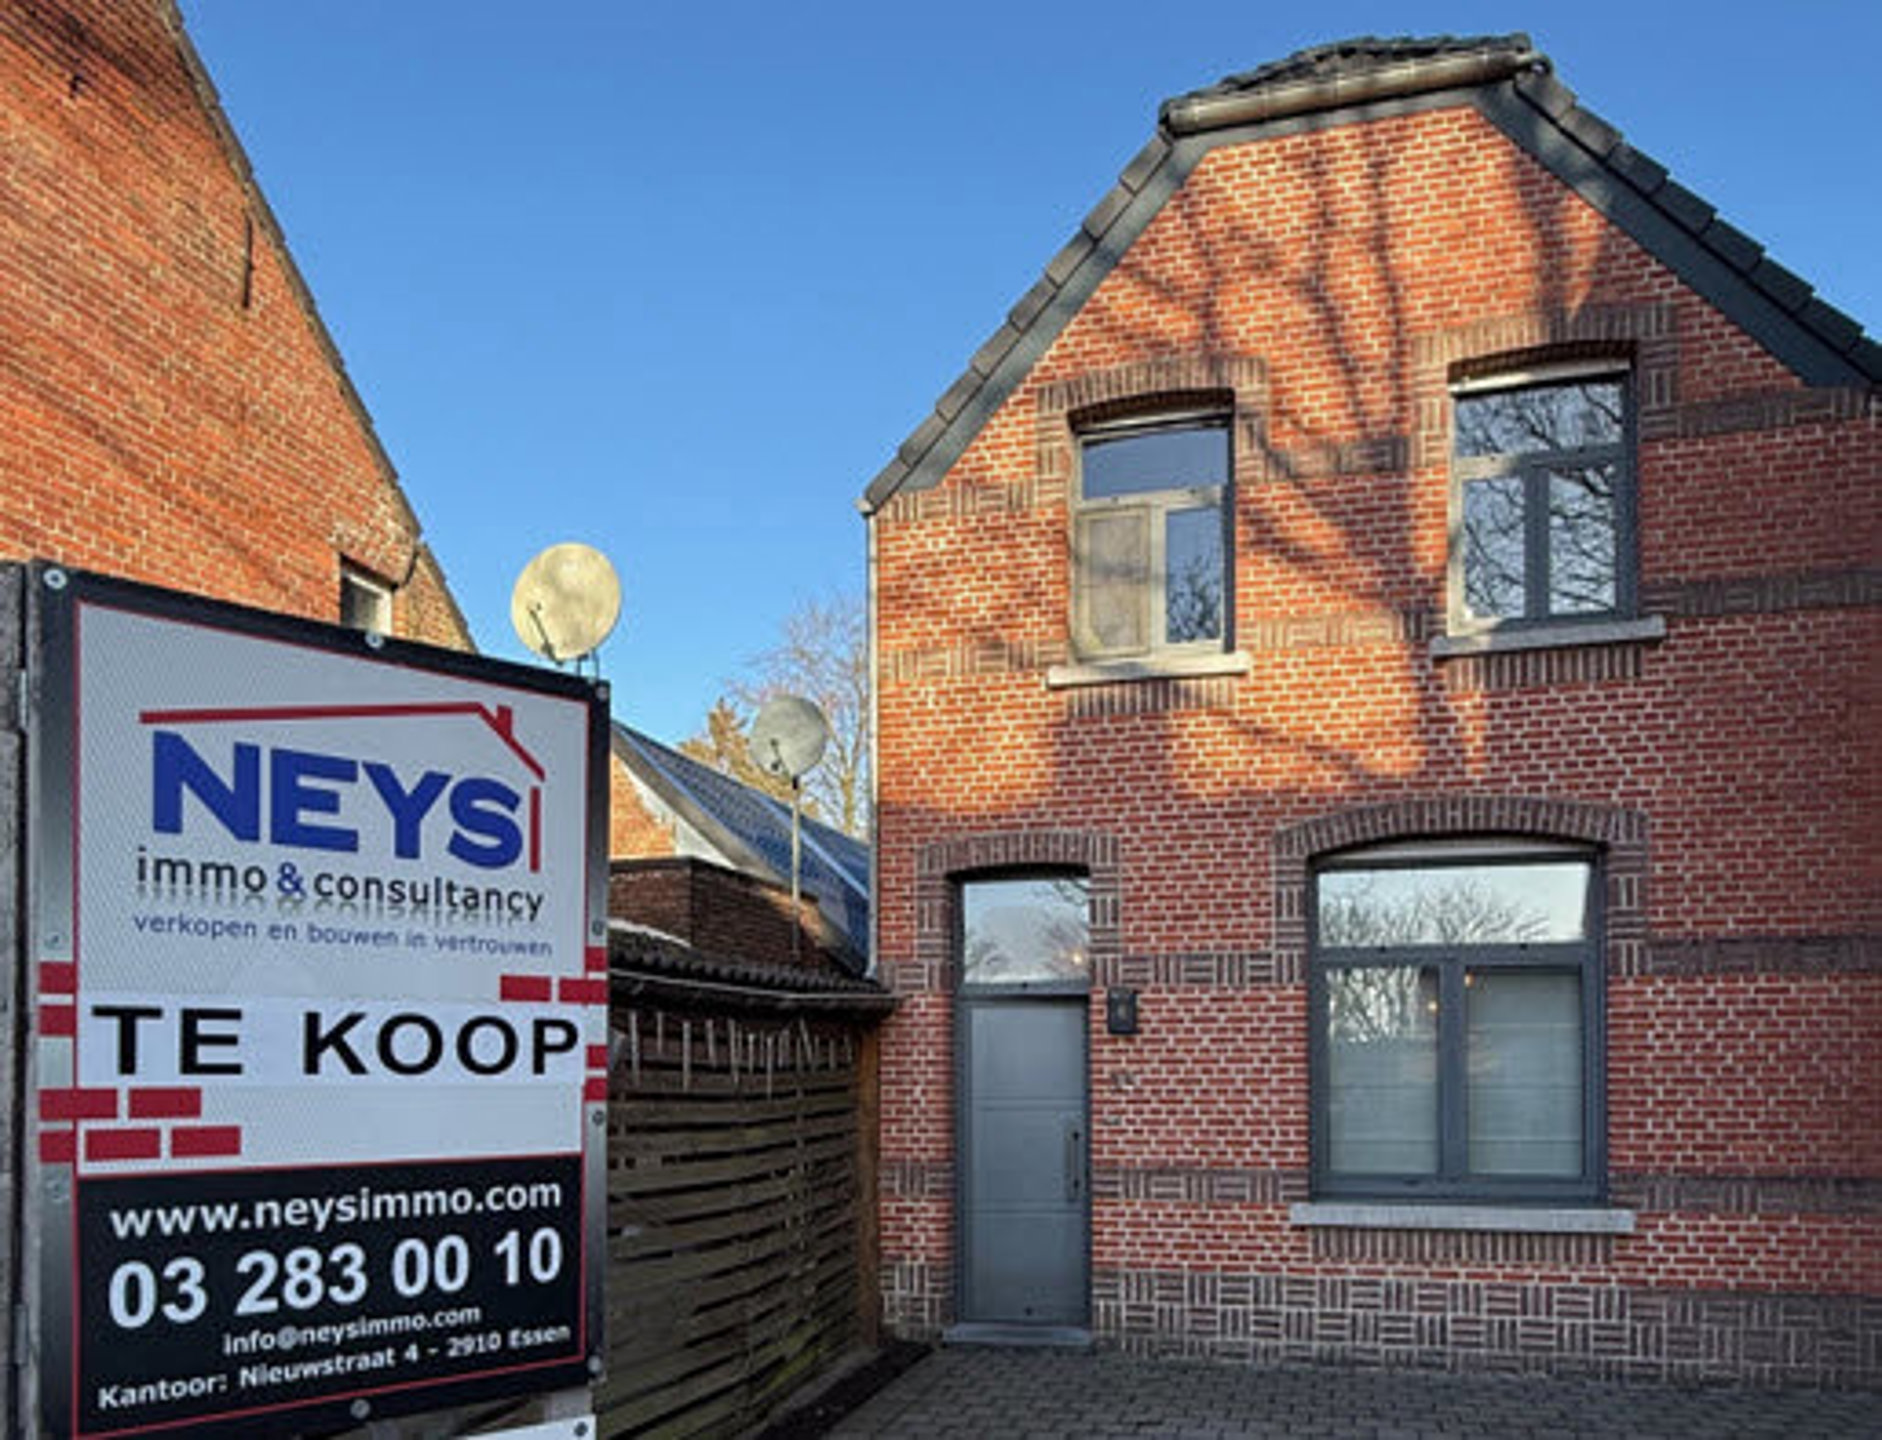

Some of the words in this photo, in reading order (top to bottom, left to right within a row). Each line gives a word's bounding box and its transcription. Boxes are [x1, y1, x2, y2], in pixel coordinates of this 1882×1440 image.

[152, 729, 524, 872] NEYS
[137, 847, 266, 894] immo
[314, 869, 545, 922] consultancy
[134, 914, 257, 942] verkopen
[269, 922, 297, 942] en
[308, 922, 398, 948] bouwen
[405, 930, 425, 948] in
[434, 932, 553, 957] vertrouwen
[92, 1006, 243, 1076] TE
[304, 1011, 579, 1076] KOOP
[109, 1182, 562, 1240] www.neysimmo.com
[108, 1256, 207, 1328] 03
[234, 1242, 367, 1318] 283
[391, 1235, 470, 1298] 00
[494, 1227, 562, 1286] 10
[222, 1304, 482, 1357] info@neysimmo.com
[98, 1373, 228, 1411] Kantoor:
[239, 1344, 396, 1388] Nieuwstraat
[403, 1340, 419, 1364] 4
[447, 1334, 500, 1358] 2910
[508, 1325, 571, 1348] Essen
